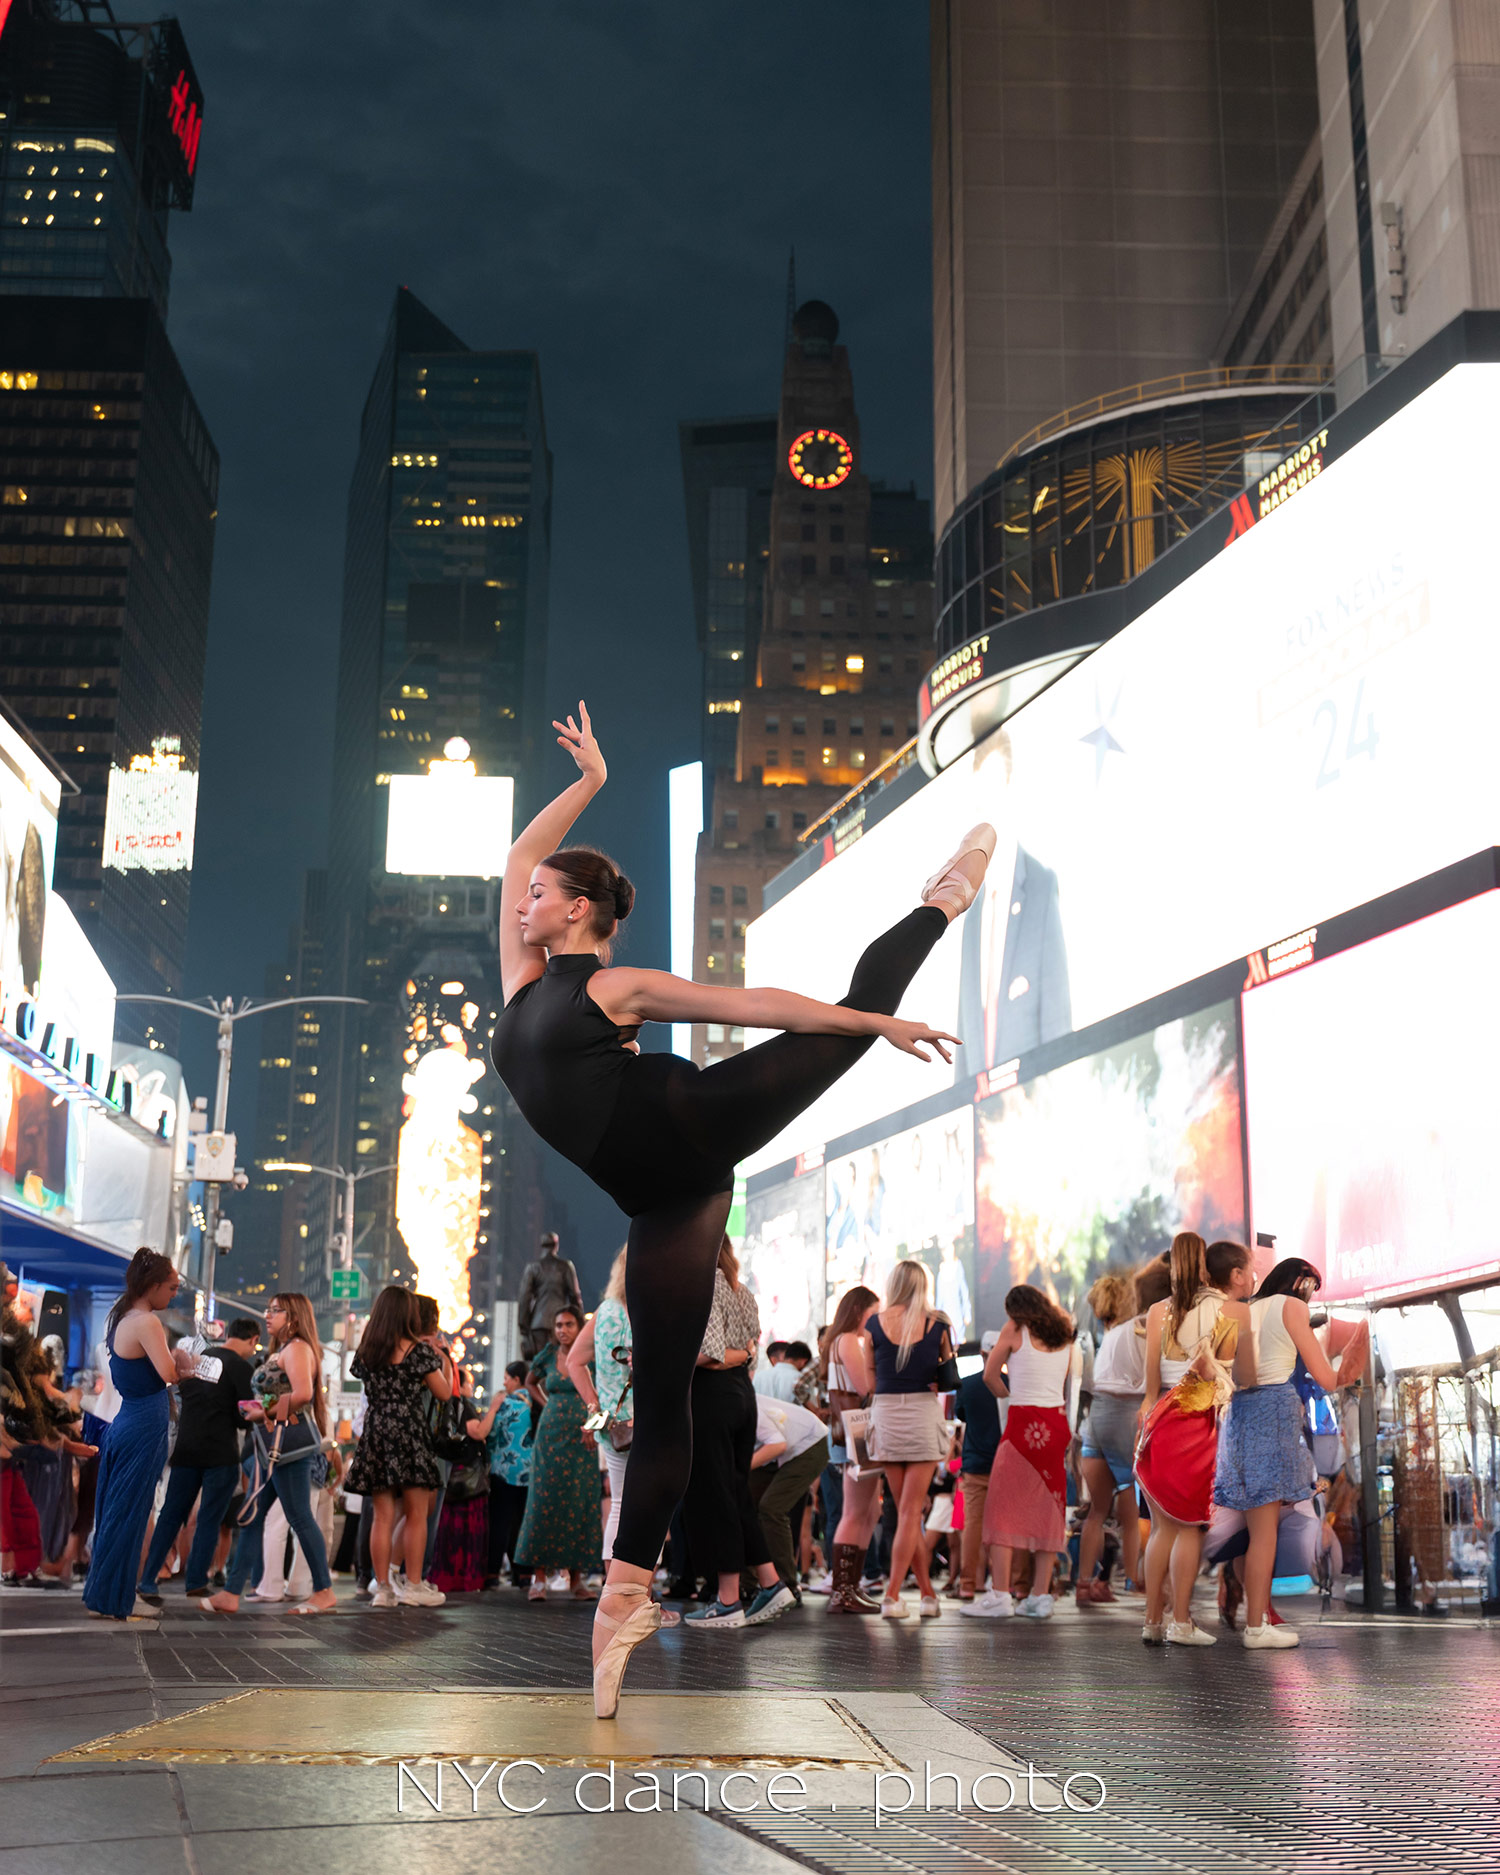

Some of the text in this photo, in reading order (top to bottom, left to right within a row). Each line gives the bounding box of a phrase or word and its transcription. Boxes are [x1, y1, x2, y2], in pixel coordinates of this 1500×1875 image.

[1259, 428, 1329, 497] MARRIOTT
[1260, 457, 1322, 518] MARQUIS
[931, 635, 990, 688] MARRIOTT
[931, 660, 982, 707] MARQUIS
[1313, 675, 1381, 791] 24
